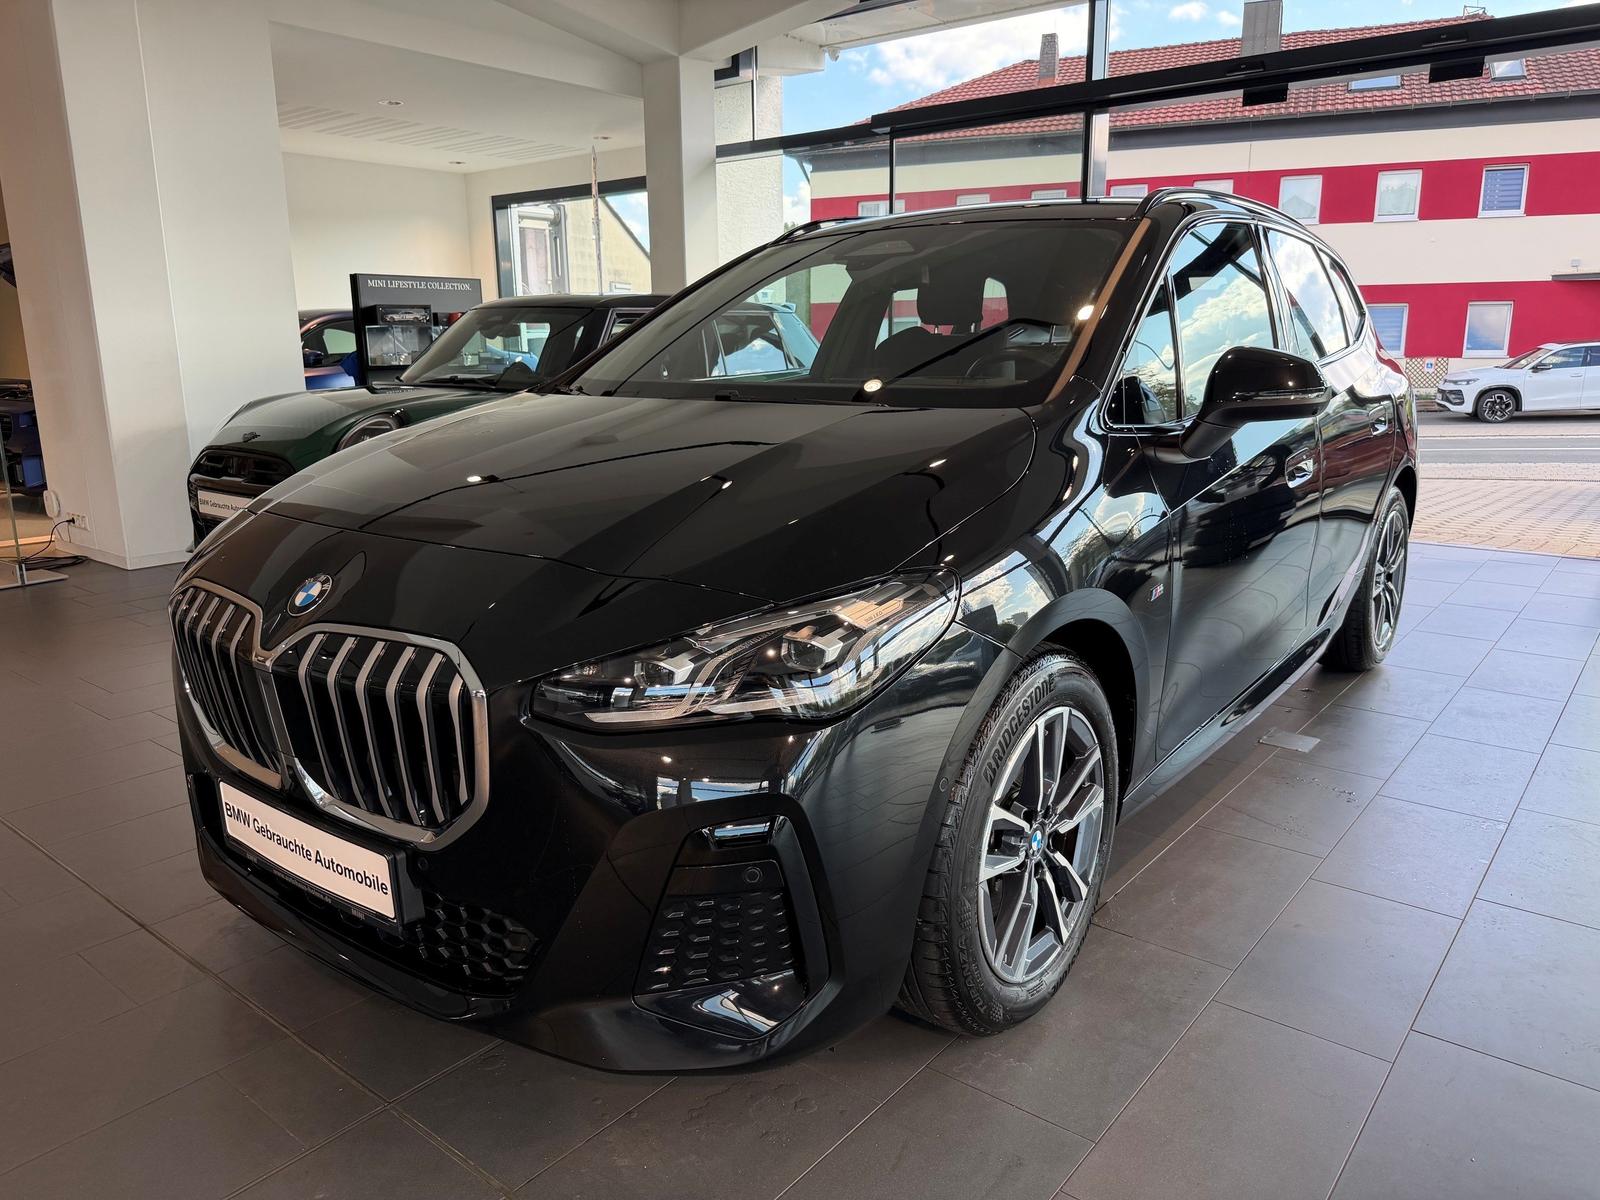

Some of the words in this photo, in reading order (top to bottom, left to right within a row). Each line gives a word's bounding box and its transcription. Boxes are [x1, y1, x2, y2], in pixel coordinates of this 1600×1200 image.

[367, 279, 386, 288] MINI
[388, 280, 427, 289] LIFESTYLE
[427, 282, 472, 291] COLLECTION.
[982, 672, 1056, 788] BRIDGESTONE
[224, 801, 251, 829] BMW
[252, 817, 312, 861] Gebrauchte
[314, 849, 389, 896] Automobile
